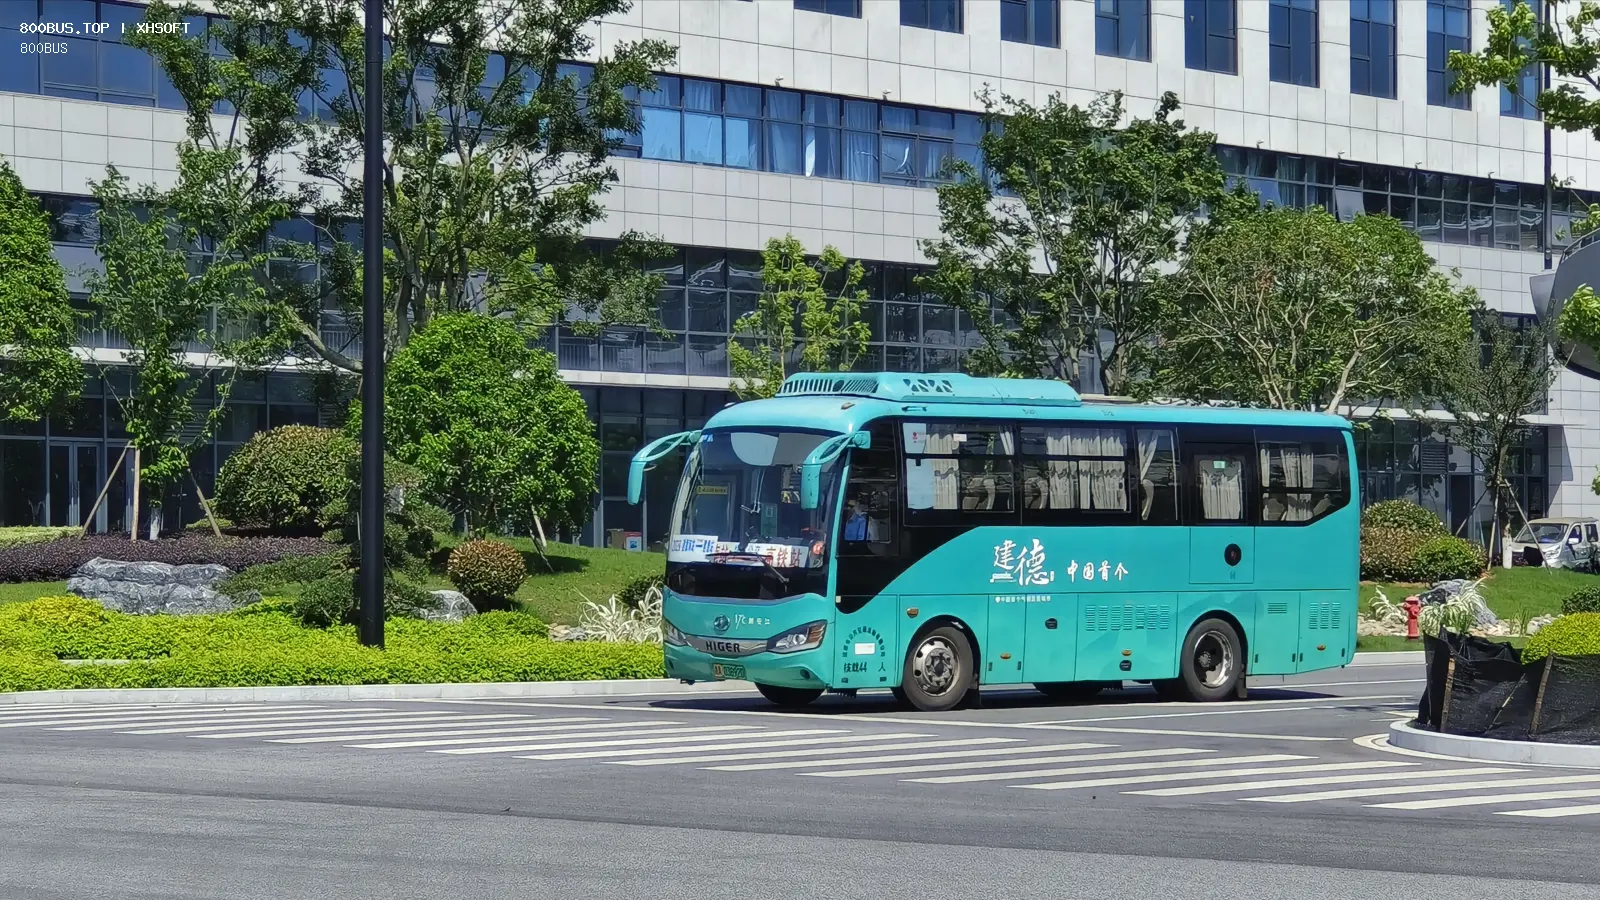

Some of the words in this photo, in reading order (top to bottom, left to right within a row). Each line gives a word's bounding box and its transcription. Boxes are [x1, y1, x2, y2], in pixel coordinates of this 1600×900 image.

[992, 538, 1050, 586] 建德
[1066, 559, 1129, 583] 中国首个
[705, 640, 741, 654] HIGER
[877, 661, 887, 672] 人
